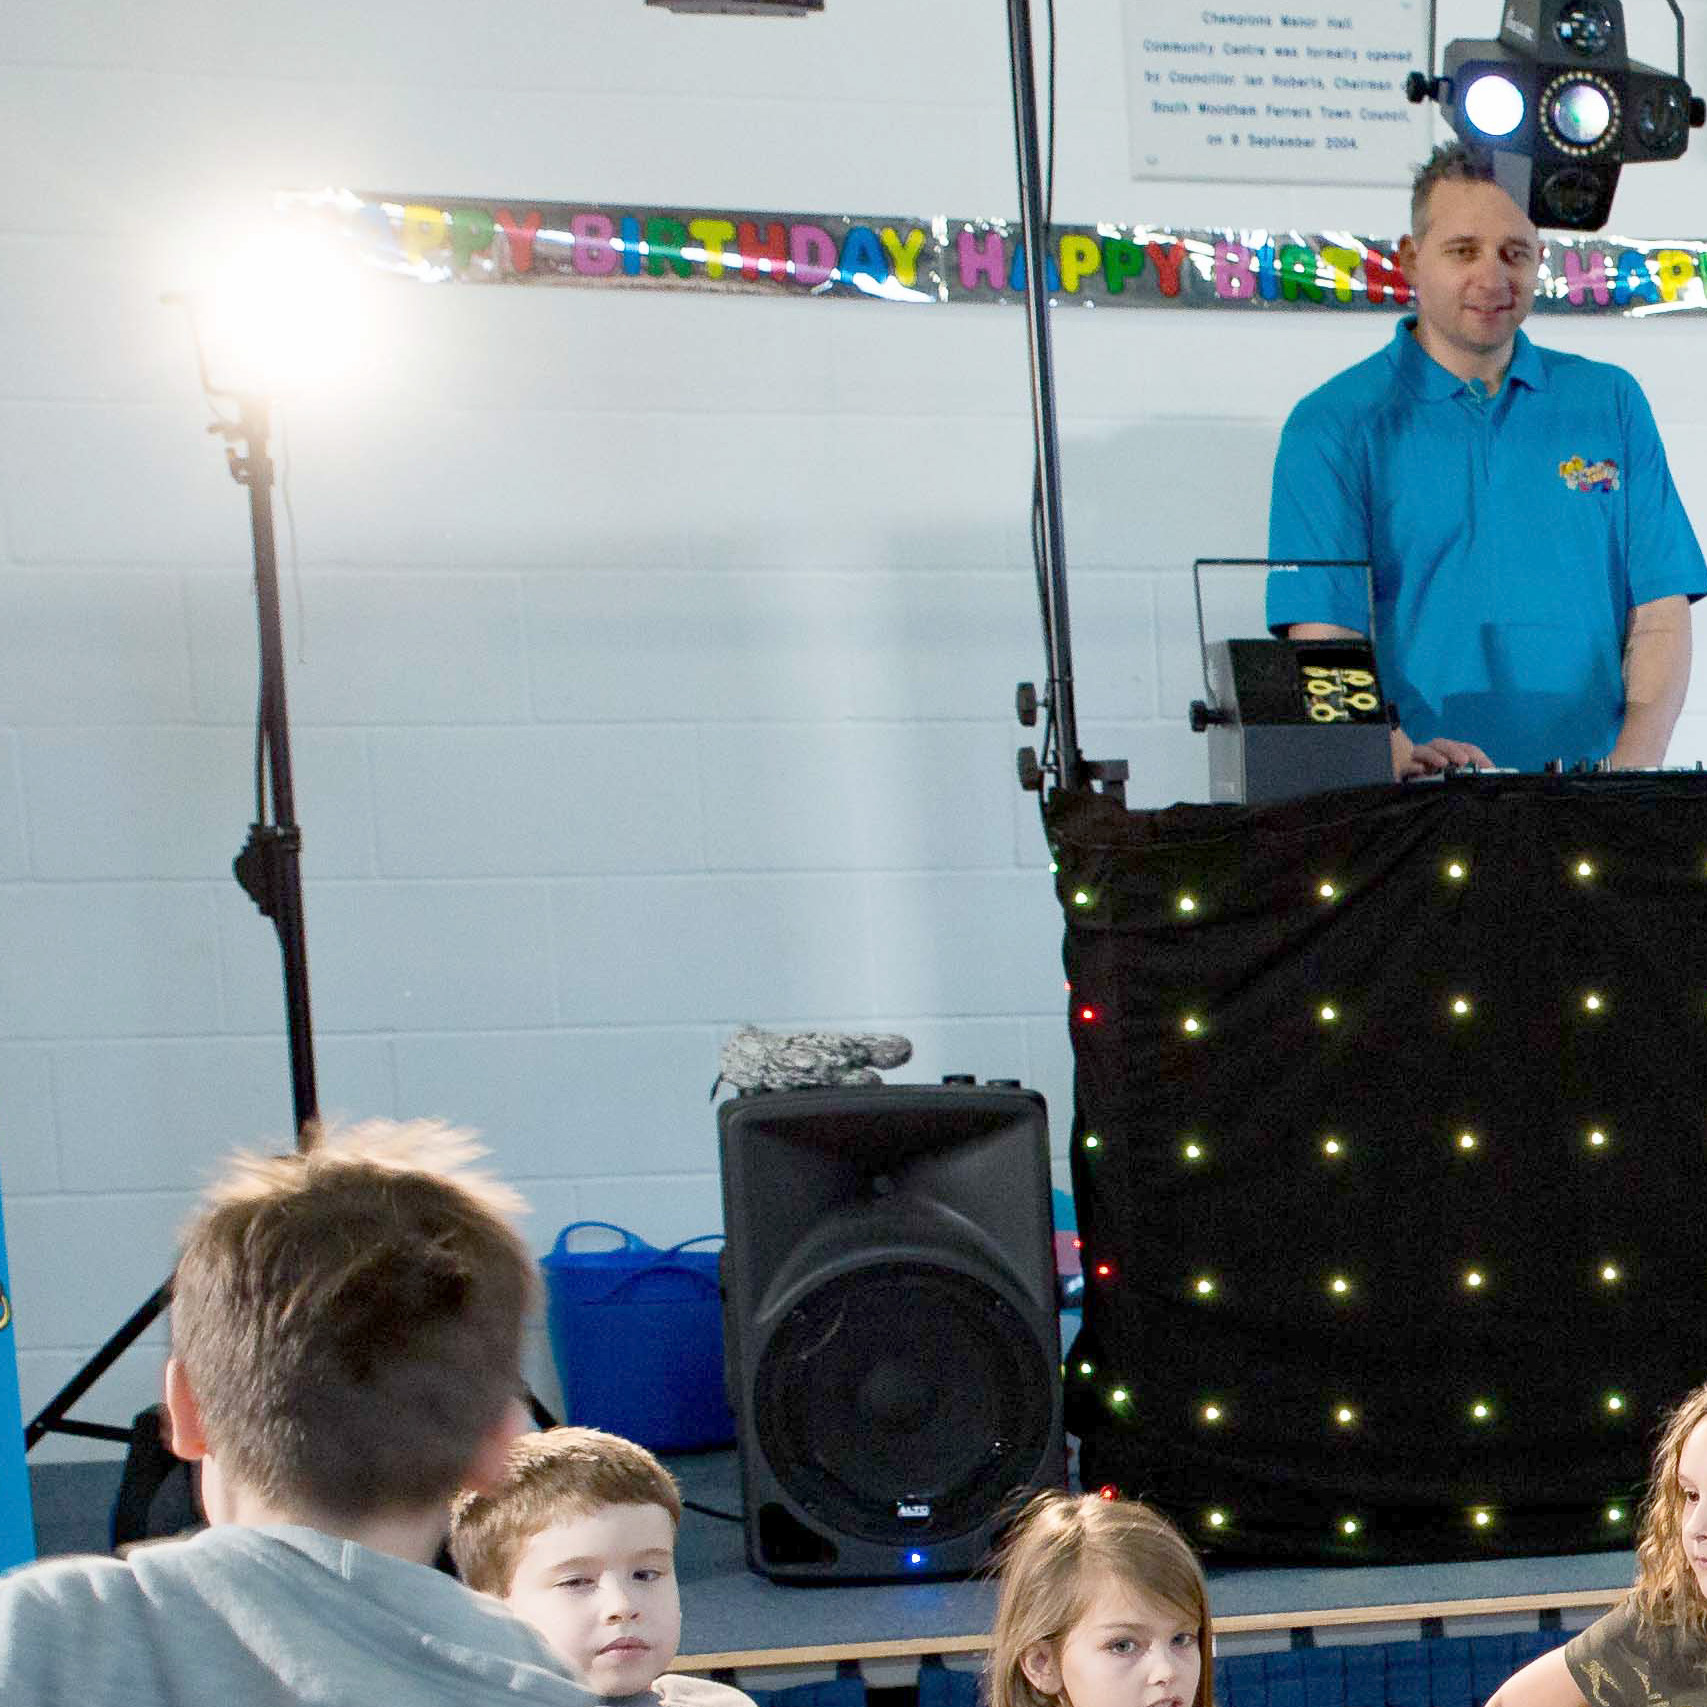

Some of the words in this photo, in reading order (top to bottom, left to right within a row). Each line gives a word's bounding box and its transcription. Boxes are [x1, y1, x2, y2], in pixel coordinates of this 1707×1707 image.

[1280, 14, 1317, 27] Manor
[1143, 38, 1213, 57] Community
[1223, 41, 1265, 56] Centre
[1273, 48, 1297, 58] was
[1366, 50, 1412, 63] opened
[1168, 71, 1234, 84] Councillor
[1335, 76, 1392, 91] Chairman
[1151, 100, 1189, 114] South
[1320, 105, 1351, 119] Town
[1247, 133, 1316, 148] September
[358, 203, 542, 273] PPY
[571, 213, 926, 288] BIRTHDAY
[1214, 240, 1416, 305] BIRTH
